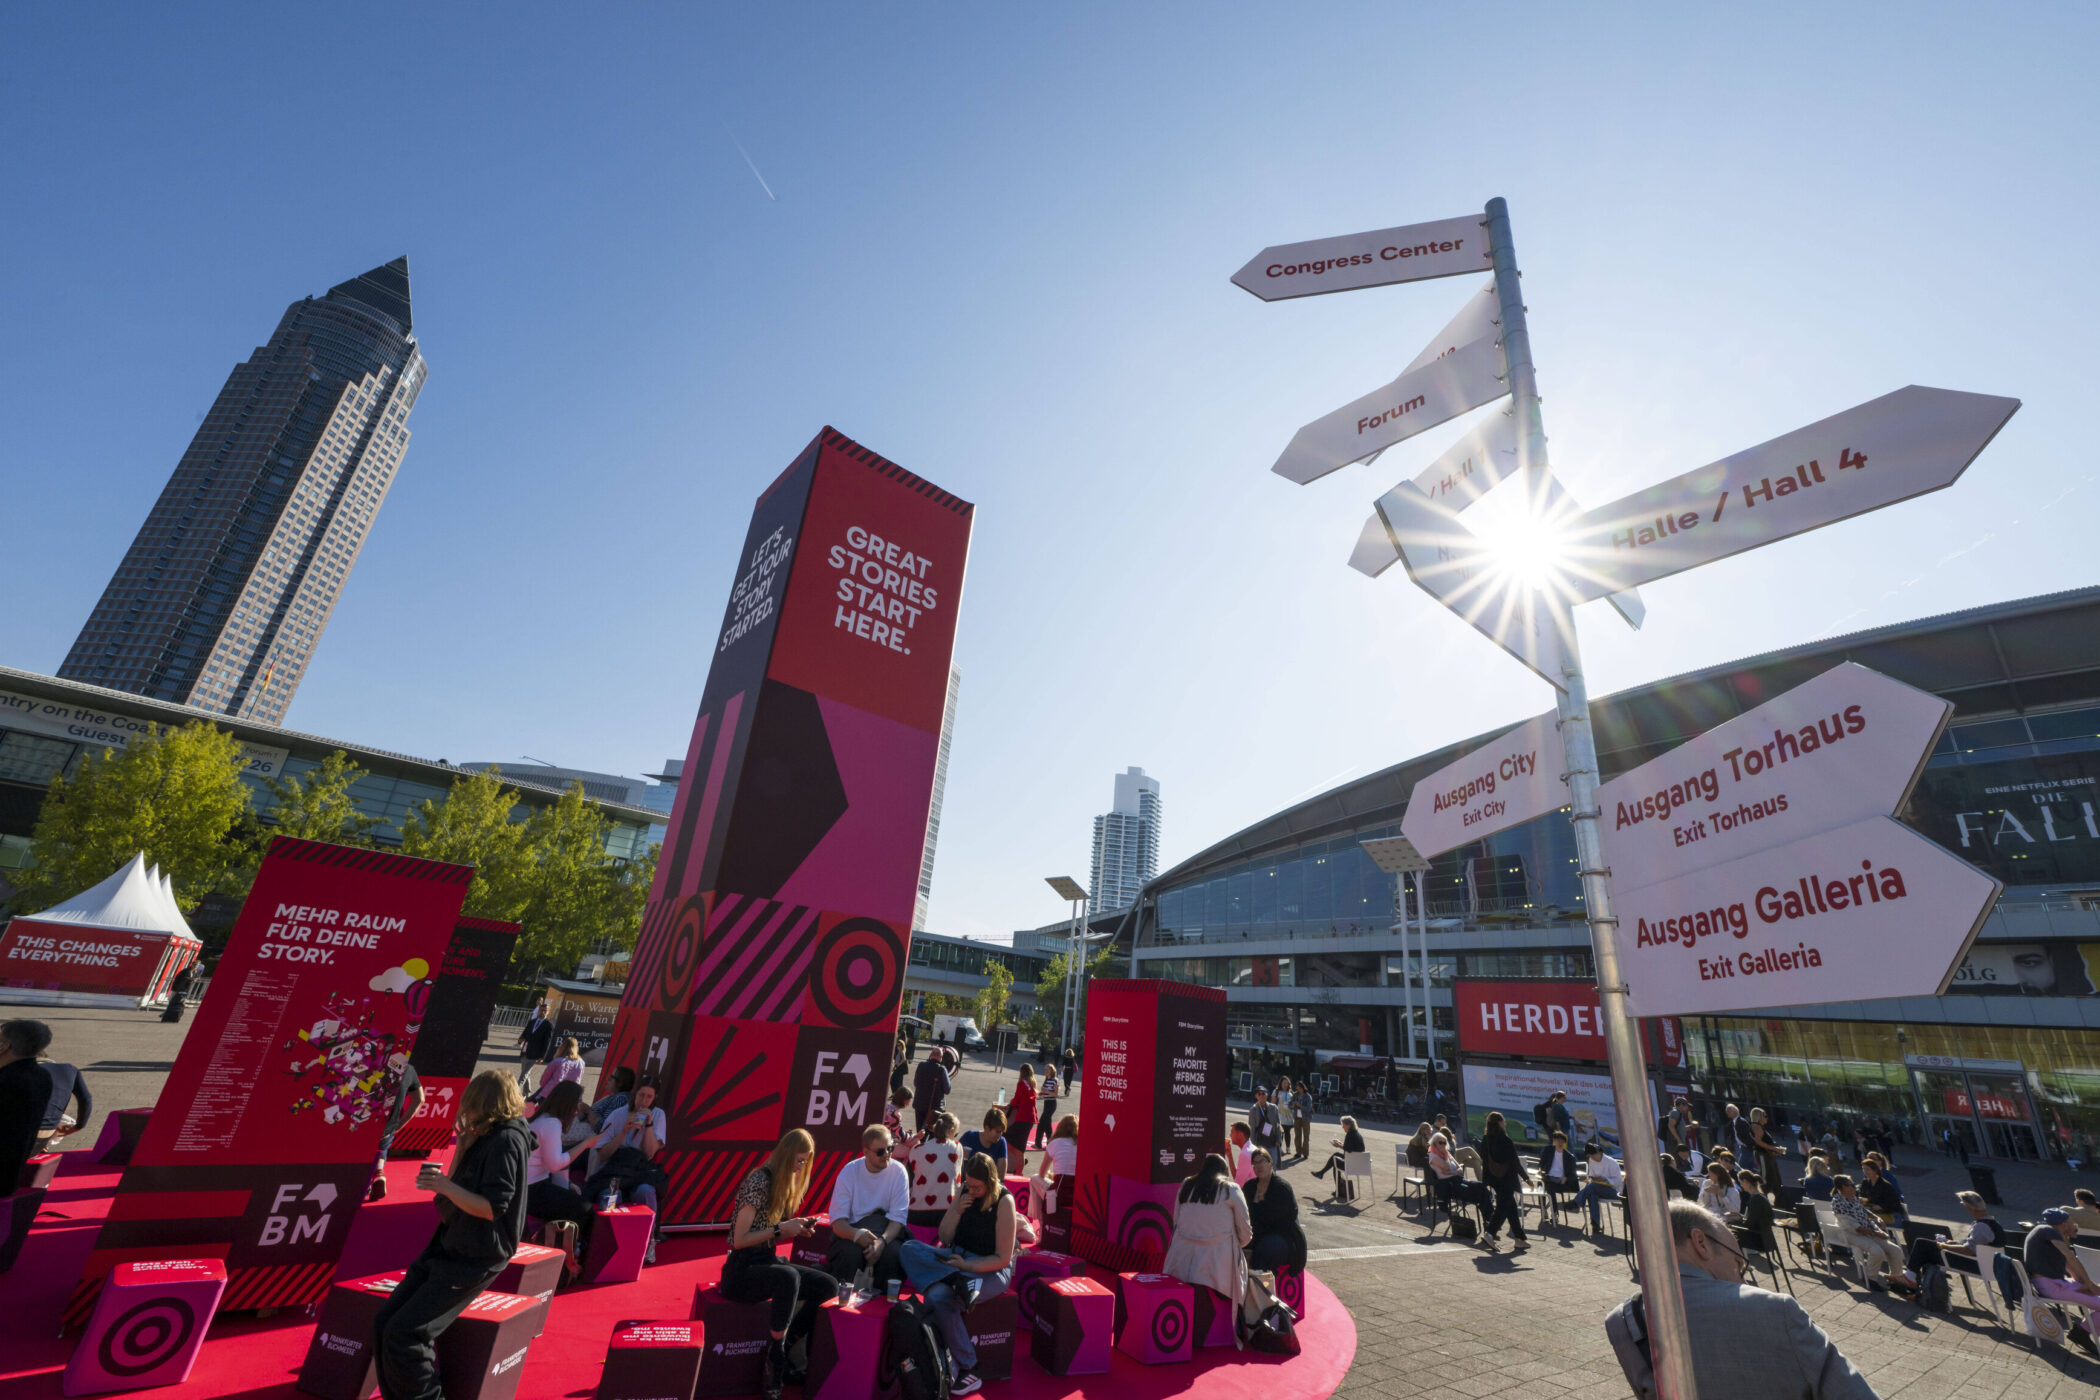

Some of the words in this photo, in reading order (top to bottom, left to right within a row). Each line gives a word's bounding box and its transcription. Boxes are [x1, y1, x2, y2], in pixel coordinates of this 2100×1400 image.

[1266, 251, 1373, 278] Congress
[1380, 239, 1464, 261] Center
[1357, 394, 1426, 435] Forum
[1611, 508, 1699, 552] Halle
[1712, 491, 1729, 523] /
[1742, 460, 1826, 508] Hall
[1838, 447, 1868, 471] 4
[752, 525, 784, 568] LET'S
[846, 526, 932, 580] GREAT
[732, 573, 755, 603] GET
[758, 538, 792, 581] YOUR
[827, 545, 938, 610] STORIES
[735, 573, 776, 621] STORY
[836, 578, 922, 629] START
[720, 597, 774, 652] STARTED.
[834, 604, 911, 655] HERE.
[43, 704, 70, 718] on
[74, 709, 107, 725] the
[112, 717, 169, 738] Coat
[68, 724, 127, 745] Guest
[1616, 768, 1720, 831] Ausgang
[1723, 704, 1866, 782] Torhaus
[1433, 771, 1496, 814] Ausgang
[1499, 750, 1536, 781] City
[1985, 785, 2010, 794] EINE
[2011, 781, 2061, 791] NETFLIX
[2062, 776, 2096, 786] SERIE
[2032, 791, 2067, 804] DIE
[1463, 809, 1482, 827] Exit
[1483, 800, 1506, 818] City
[1673, 820, 1706, 847] Exit
[1709, 793, 1789, 833] Torhaus
[1637, 902, 1749, 949] Ausgang
[1755, 859, 1907, 924] Galleria
[274, 903, 339, 926] MEHR
[343, 912, 406, 933] RAUM
[17, 935, 56, 949] THIS
[60, 939, 142, 957] CHANGES
[266, 920, 312, 943] FÜR
[315, 927, 381, 950] DEINE
[8, 948, 120, 967] EVERYTHING.
[257, 942, 335, 966] STORY.
[1698, 955, 1735, 981] Exit
[1738, 943, 1822, 976] Galleria
[1260, 960, 1272, 984] 3
[564, 1000, 584, 1012] Das
[574, 1012, 591, 1023] hat
[593, 1014, 608, 1024] ein
[1101, 1051, 1127, 1063] WHERE
[1102, 1039, 1118, 1050] THIS
[1119, 1040, 1127, 1050] IS
[1185, 1046, 1197, 1057] MY
[812, 1051, 839, 1086] F
[1101, 1064, 1125, 1076] GREAT
[1173, 1058, 1207, 1070] FAVORITE
[1097, 1076, 1128, 1089] STORIES
[1175, 1071, 1205, 1083] #FBM26
[1099, 1089, 1124, 1102] START.
[1172, 1084, 1206, 1096] MOMENT
[415, 1102, 450, 1118] BM
[805, 1089, 869, 1126] BM
[270, 1184, 303, 1214] F
[257, 1214, 331, 1247] BM
[329, 1334, 362, 1350] FRANKFURTER
[726, 1340, 767, 1349] FRANKFURTER
[979, 1338, 1006, 1346] BUCHMESSE
[980, 1331, 1011, 1340] FRANKFURTER
[327, 1342, 356, 1356] BUCHMESSE
